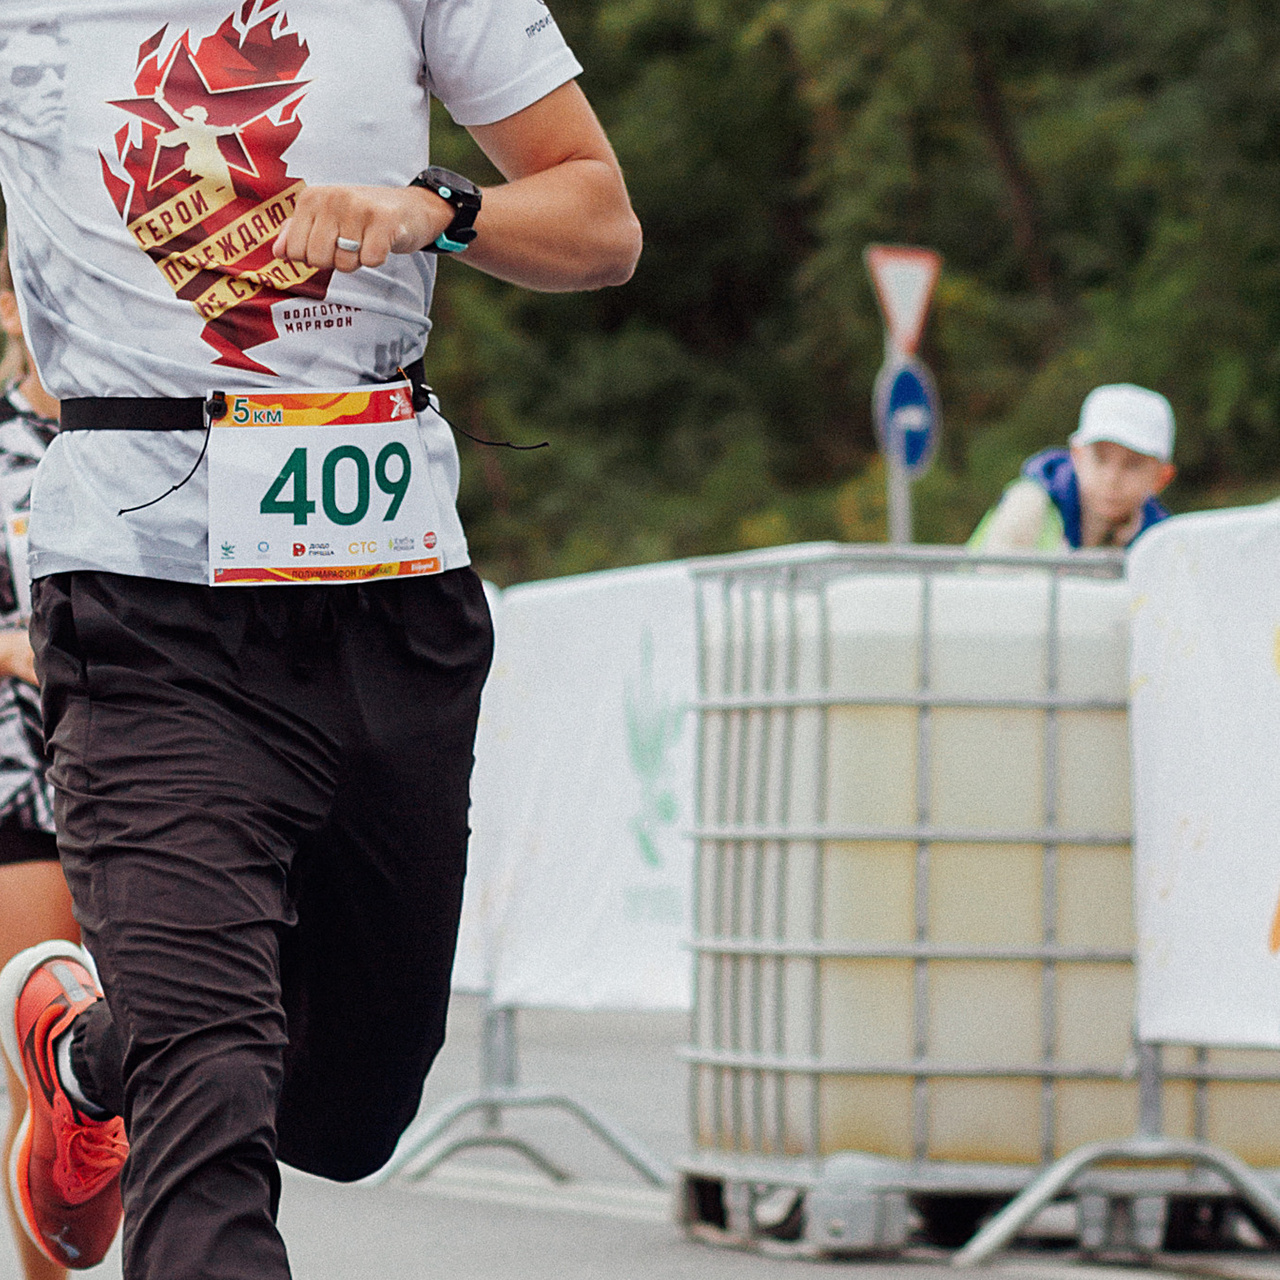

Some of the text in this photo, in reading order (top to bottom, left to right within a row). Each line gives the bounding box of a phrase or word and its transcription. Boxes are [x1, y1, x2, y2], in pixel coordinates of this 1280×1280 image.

[133, 190, 209, 246] ГЕРОИ
[283, 303, 362, 320] ВОЛГОГР
[285, 316, 353, 334] МАРАФОН
[233, 398, 250, 423] 5
[260, 441, 412, 526] 409
